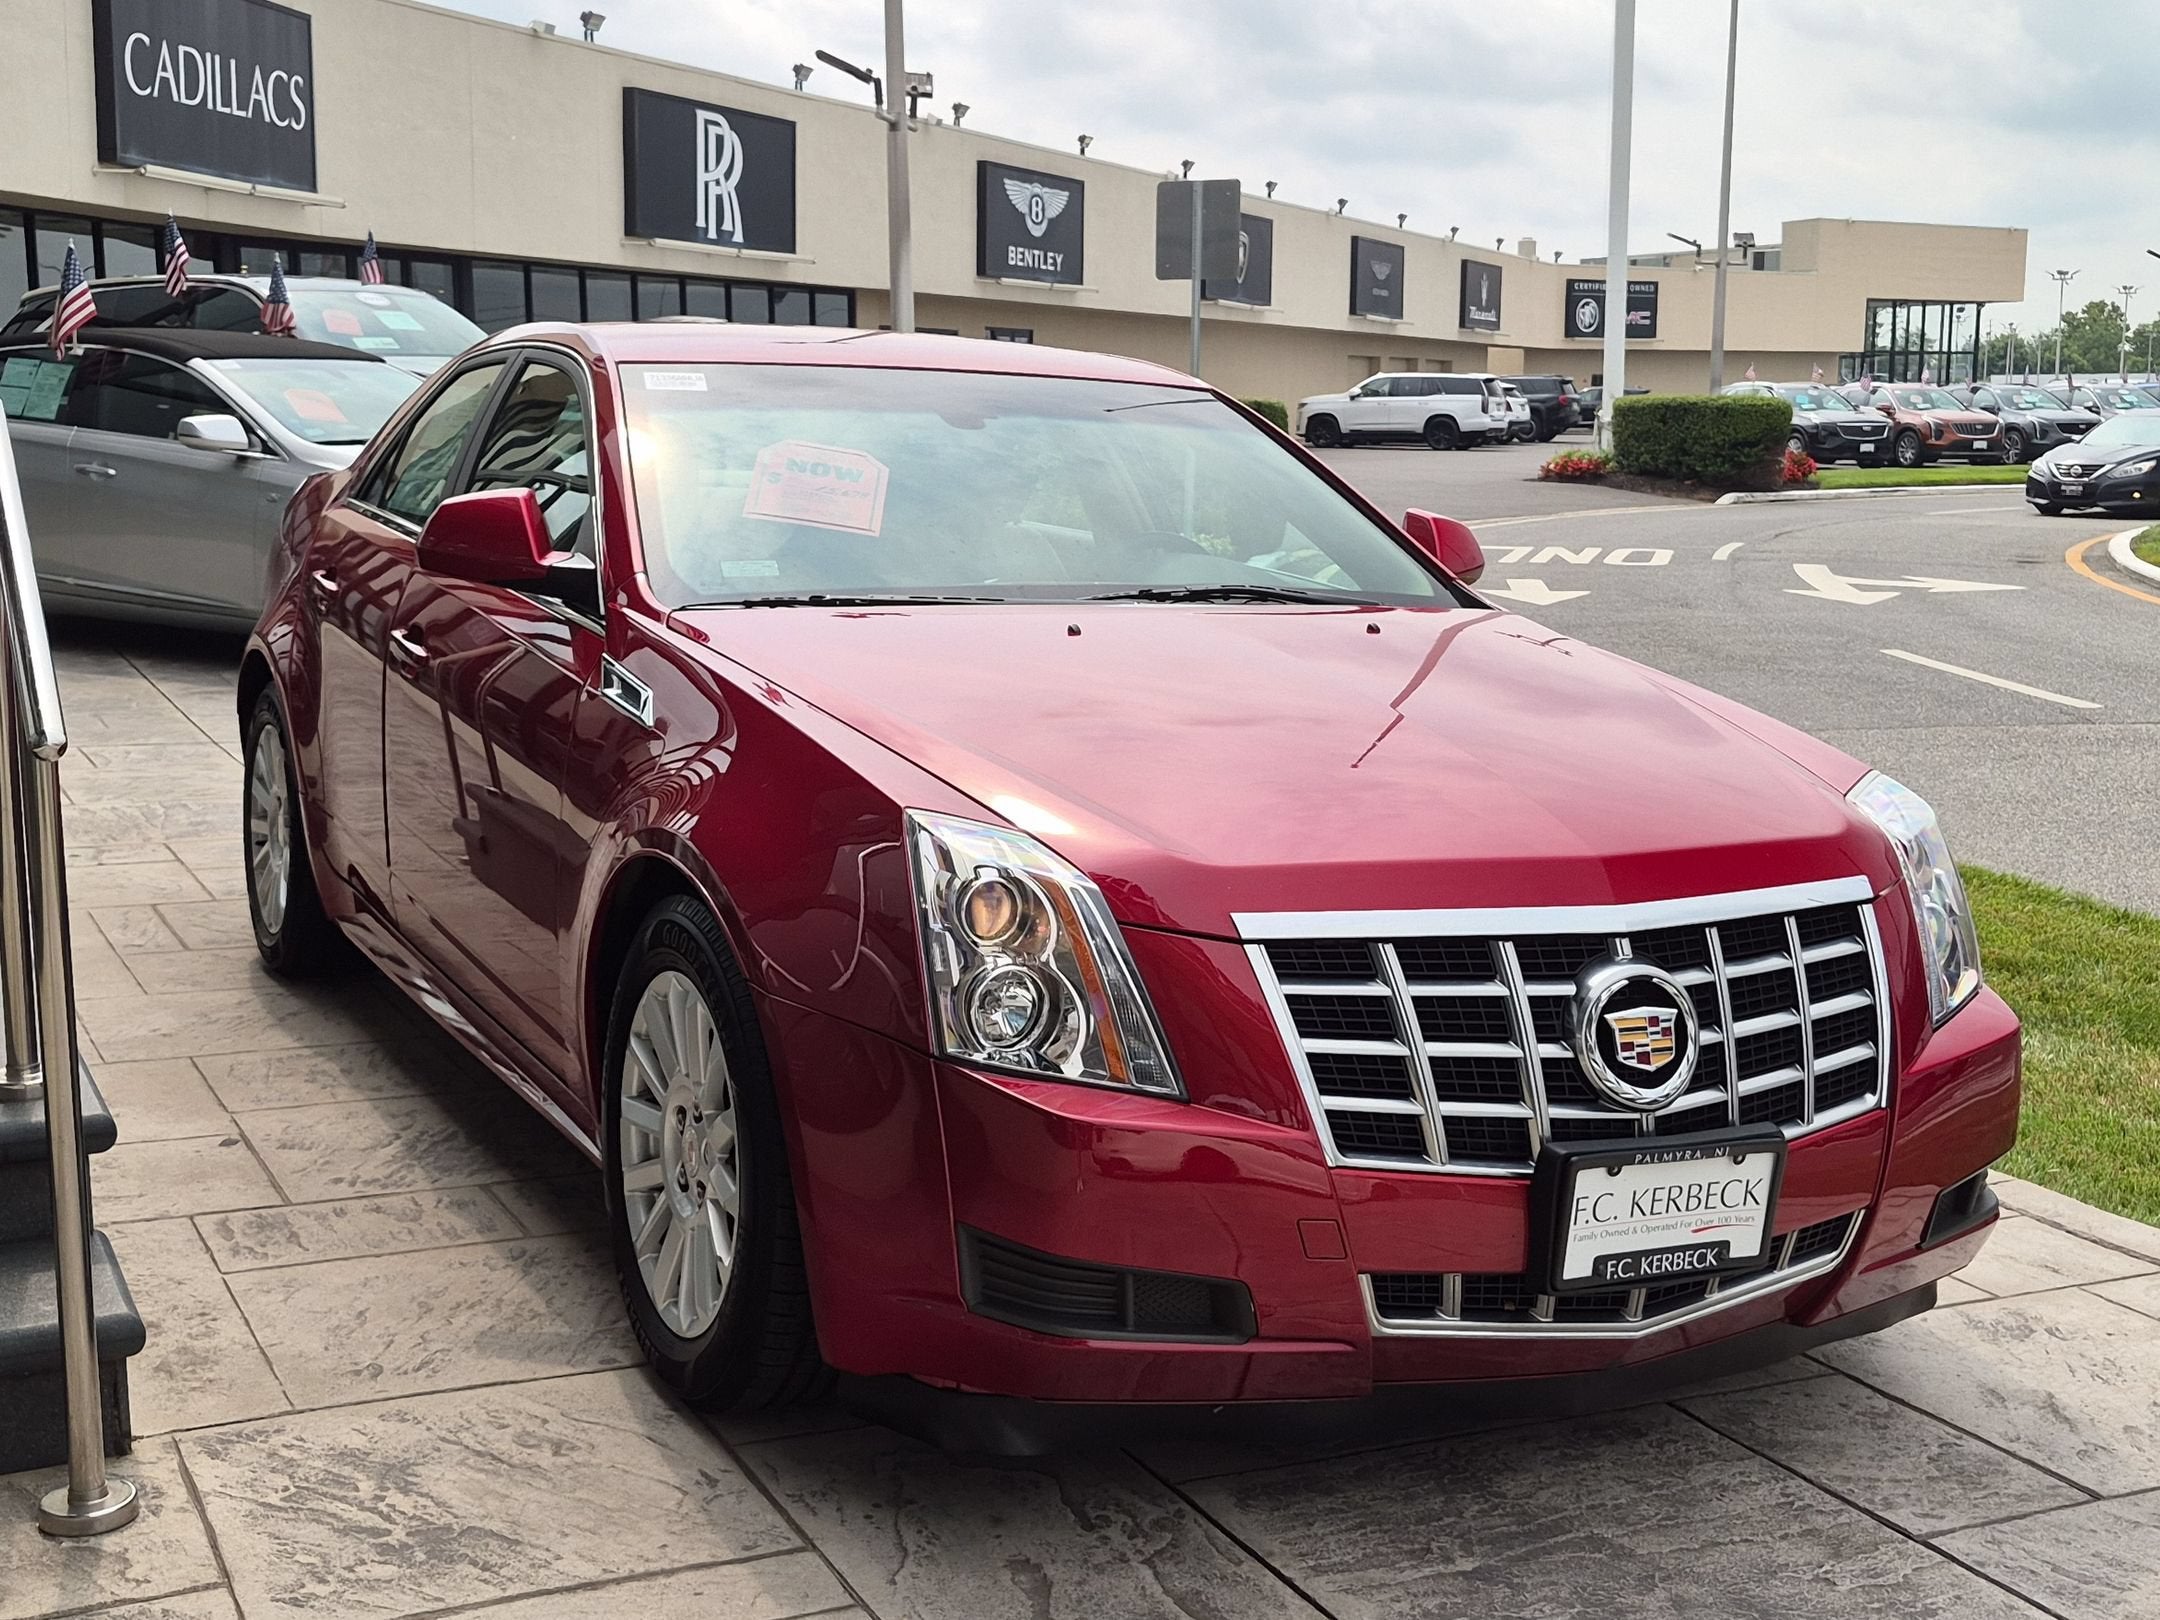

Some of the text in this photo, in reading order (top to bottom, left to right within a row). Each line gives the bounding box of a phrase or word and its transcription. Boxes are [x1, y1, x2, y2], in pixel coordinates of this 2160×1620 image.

[124, 32, 306, 130] CADILLACS
[1008, 245, 1063, 271] BENTLEY
[1626, 311, 1651, 325] MC
[786, 458, 864, 482] NOW
[1480, 546, 1675, 566] ONL
[1714, 1146, 1730, 1157] NJ
[1573, 1178, 1763, 1226] F.C. KERBECK
[1573, 1213, 1755, 1242] Family Owned & Operated For Over 100 Years
[1606, 1247, 1719, 1280] F.C. KERBECK
